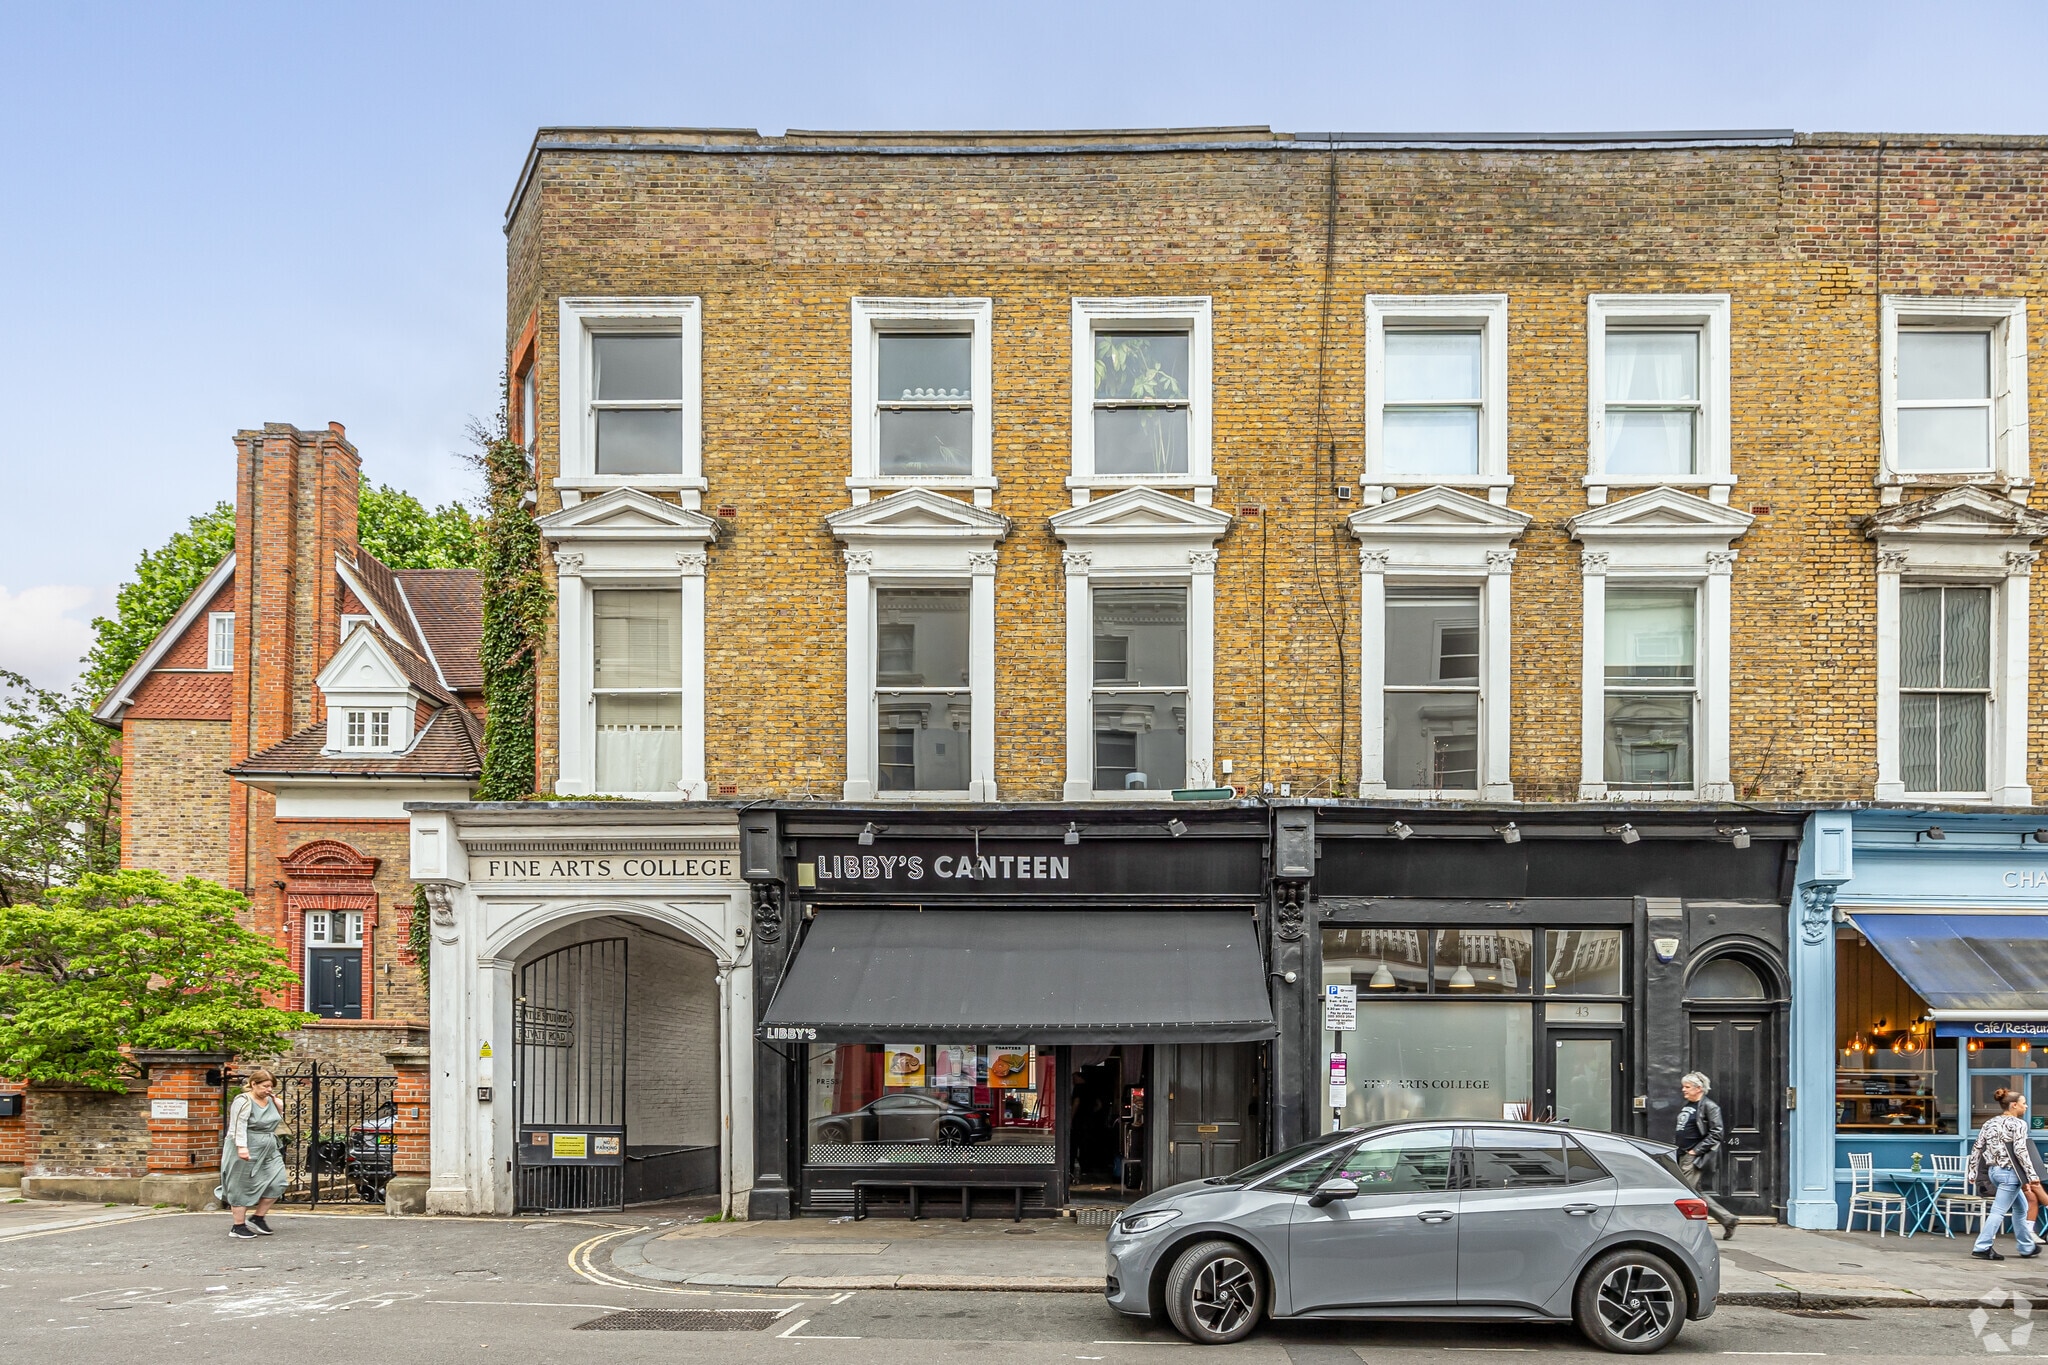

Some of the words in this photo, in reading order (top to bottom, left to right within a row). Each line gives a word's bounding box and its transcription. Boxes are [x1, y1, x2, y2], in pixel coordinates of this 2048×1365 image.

[488, 860, 541, 877] FINE
[550, 859, 611, 877] ARTS
[623, 859, 732, 877] COLLEGE
[818, 855, 924, 880] LIBBY'S
[934, 855, 1069, 879] CANTEEN
[2002, 870, 2048, 889] CHA
[1575, 1006, 1590, 1017] 43
[767, 1027, 817, 1040] LIBBY'S
[1431, 1079, 1490, 1089] COLLEGE
